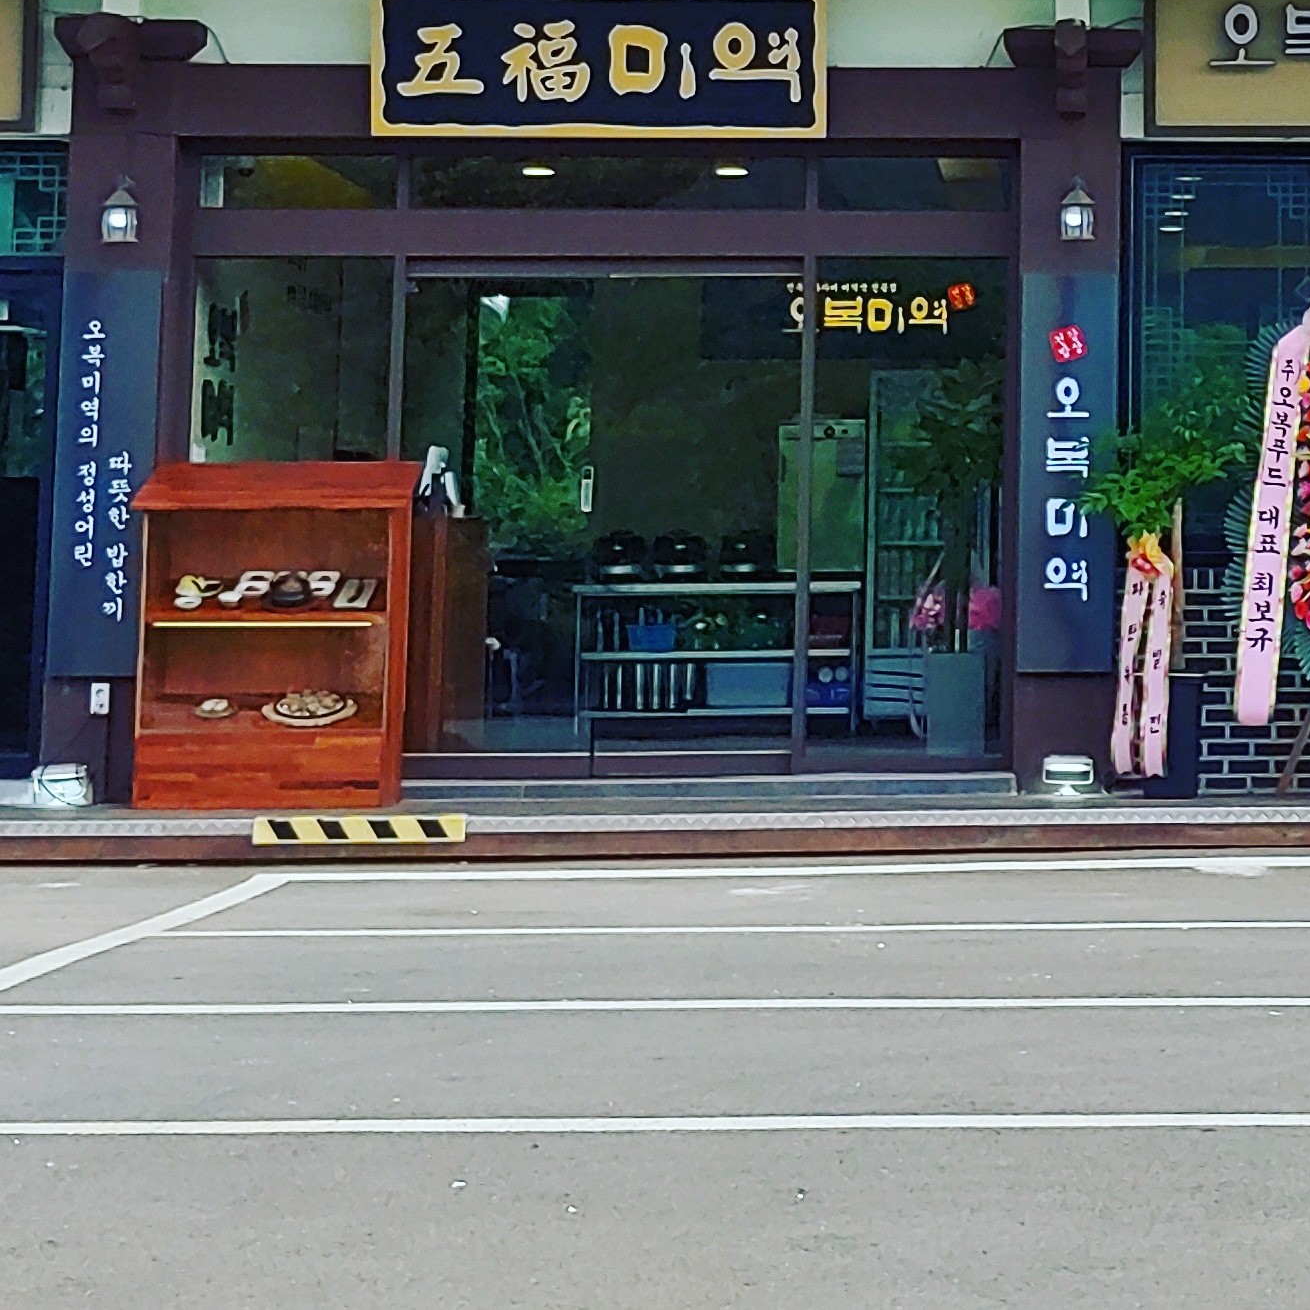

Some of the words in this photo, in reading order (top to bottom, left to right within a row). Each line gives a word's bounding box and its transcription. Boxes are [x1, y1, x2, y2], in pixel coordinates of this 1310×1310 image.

[397, 19, 802, 103] 五福미역
[77, 320, 106, 448] 오복미역의
[74, 461, 97, 567] 정성어린
[107, 450, 133, 530] 따뜻한
[1043, 376, 1090, 602] 오복미역
[1254, 505, 1281, 555] 대표
[1246, 571, 1274, 653] 최보규
